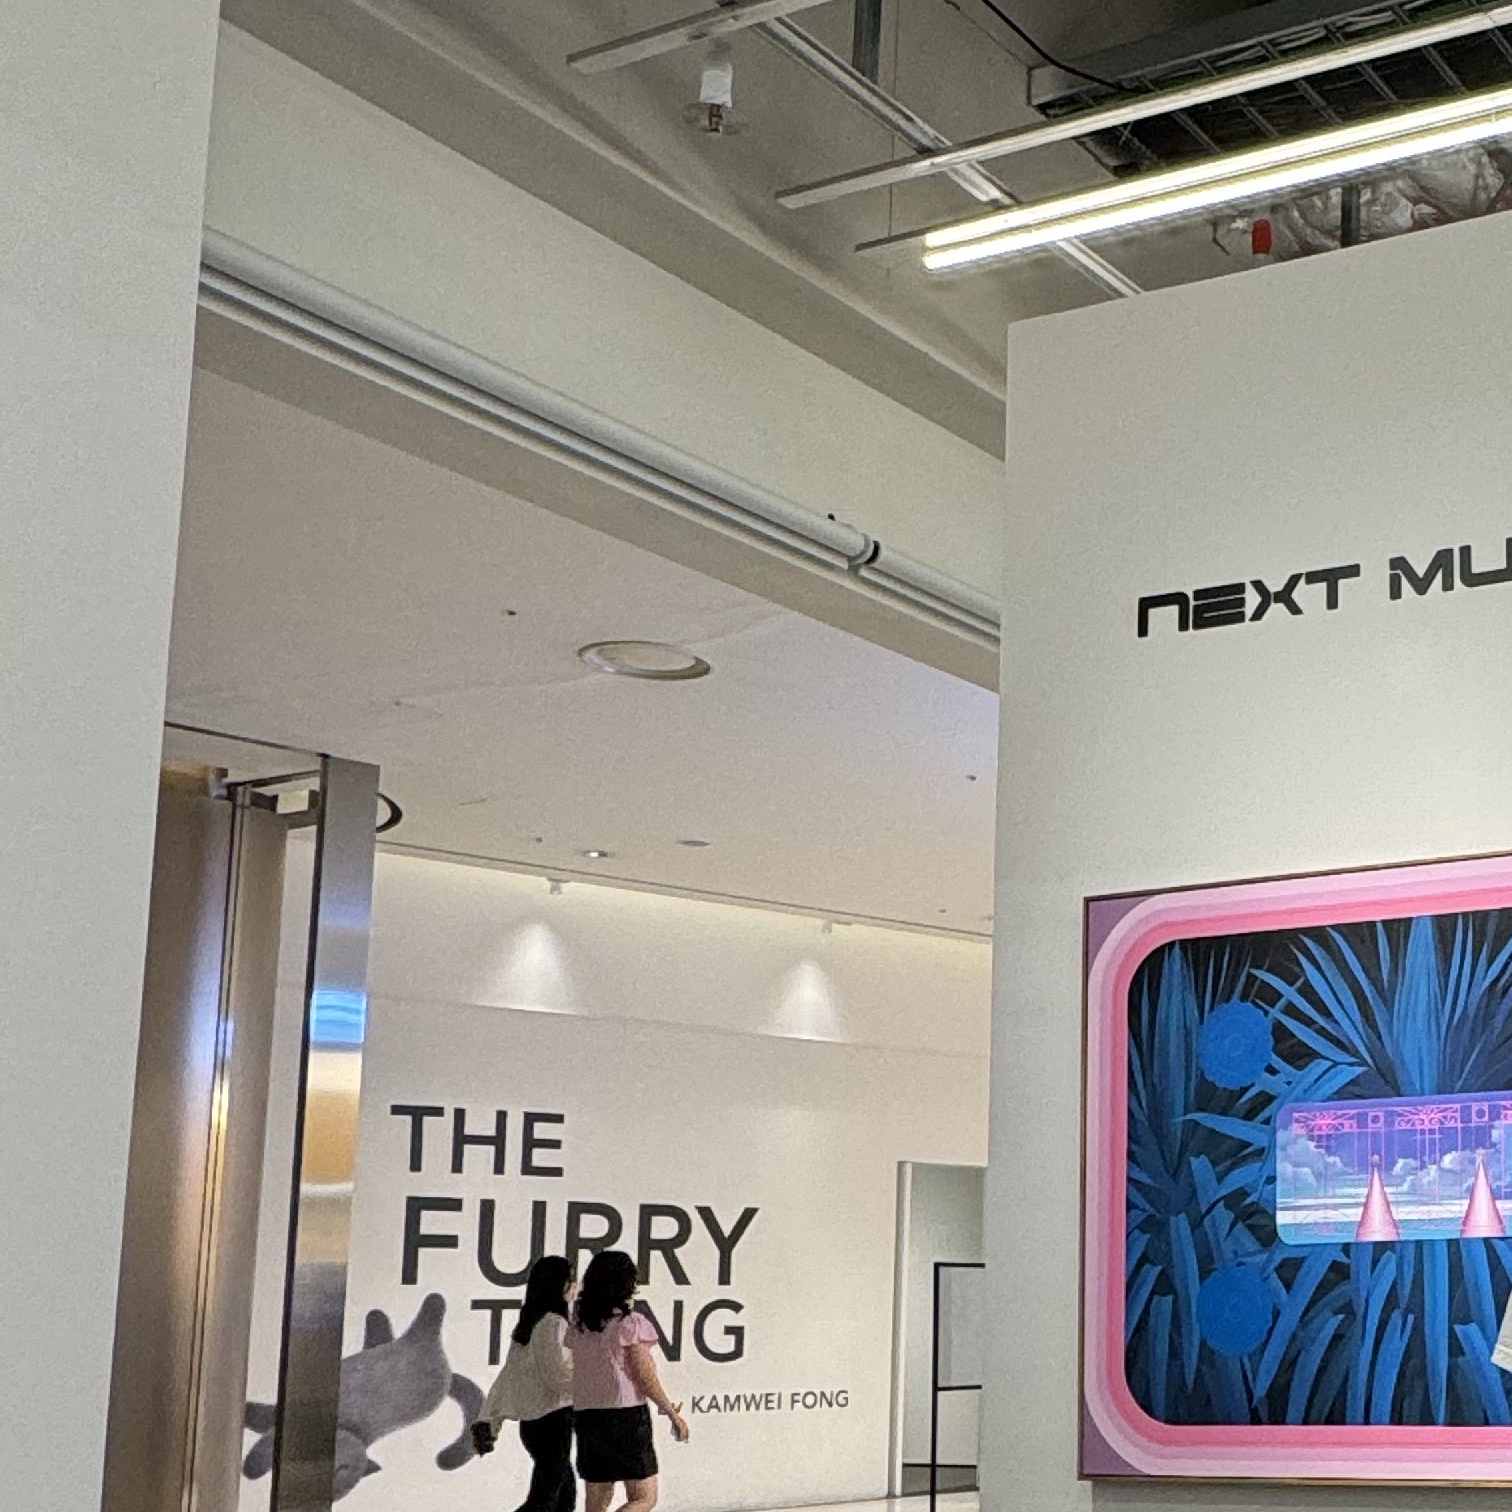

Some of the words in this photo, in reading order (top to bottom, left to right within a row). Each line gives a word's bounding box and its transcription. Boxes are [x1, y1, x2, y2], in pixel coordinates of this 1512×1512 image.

[1137, 563, 1360, 638] NEXT
[390, 1104, 565, 1177] THE
[400, 1195, 760, 1288] FURRY
[469, 1298, 746, 1366] TNG
[691, 1391, 782, 1414] KAMWEI
[790, 1390, 849, 1411] FONG
